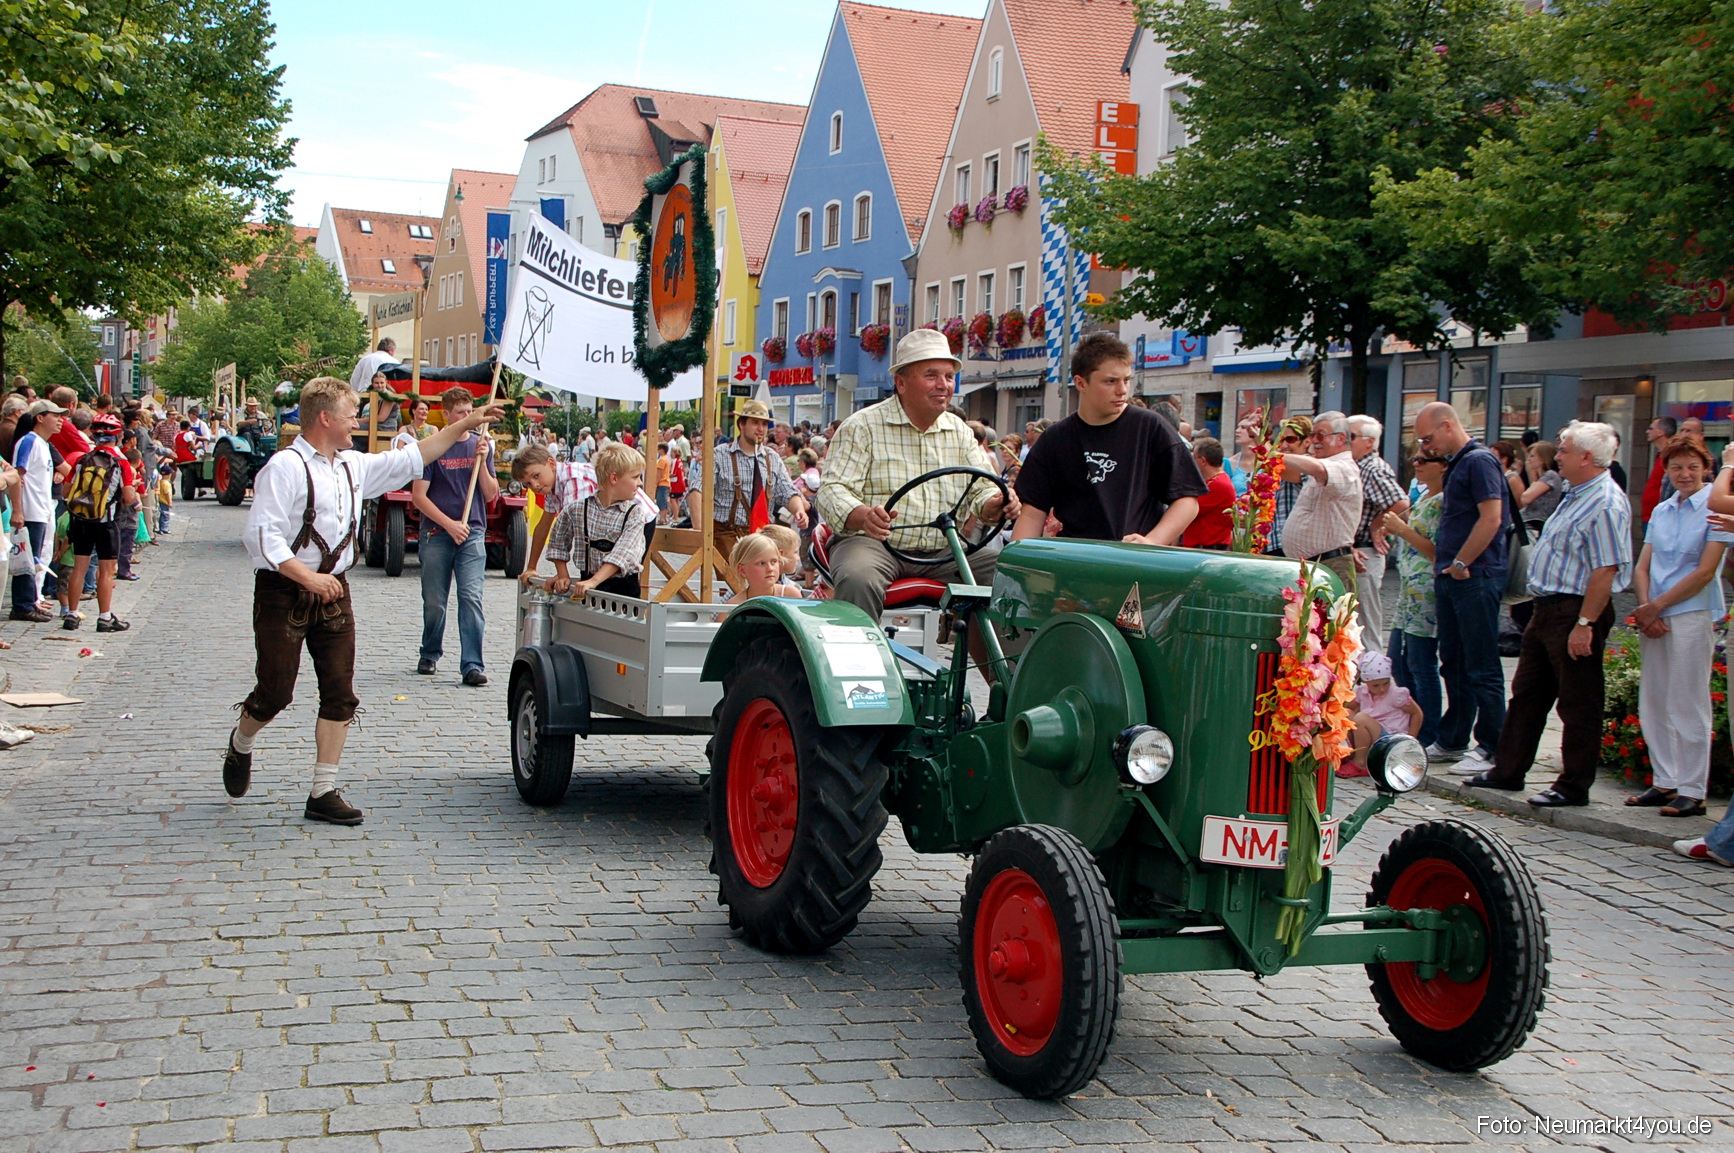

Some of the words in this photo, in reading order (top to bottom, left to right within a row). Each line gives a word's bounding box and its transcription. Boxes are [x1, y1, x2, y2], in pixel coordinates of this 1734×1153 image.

[527, 225, 635, 301] Milchliefer
[585, 343, 614, 364] Ich
[768, 366, 815, 387] APOTHEKE
[852, 692, 885, 700] ATLANTIC
